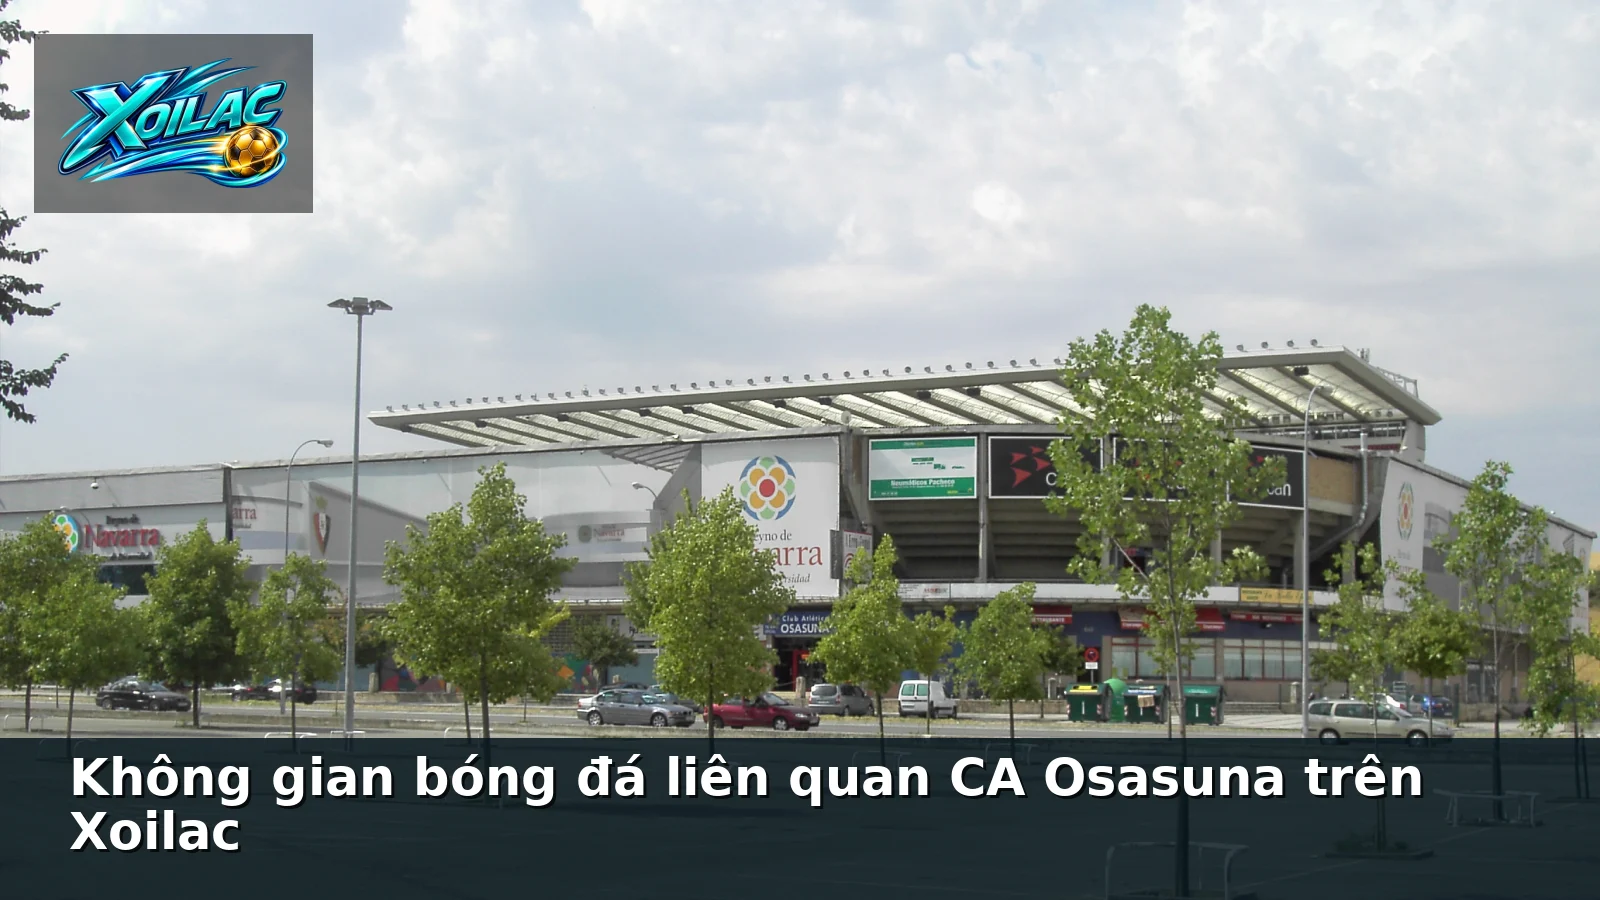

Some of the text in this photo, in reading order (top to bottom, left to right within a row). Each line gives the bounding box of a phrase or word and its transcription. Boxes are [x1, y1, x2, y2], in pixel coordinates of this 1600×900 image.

[231, 507, 257, 520] arra
[84, 523, 159, 548] Navarra
[753, 529, 793, 545] eyno de
[783, 573, 811, 583] rsidad
[801, 614, 828, 622] Atlétic
